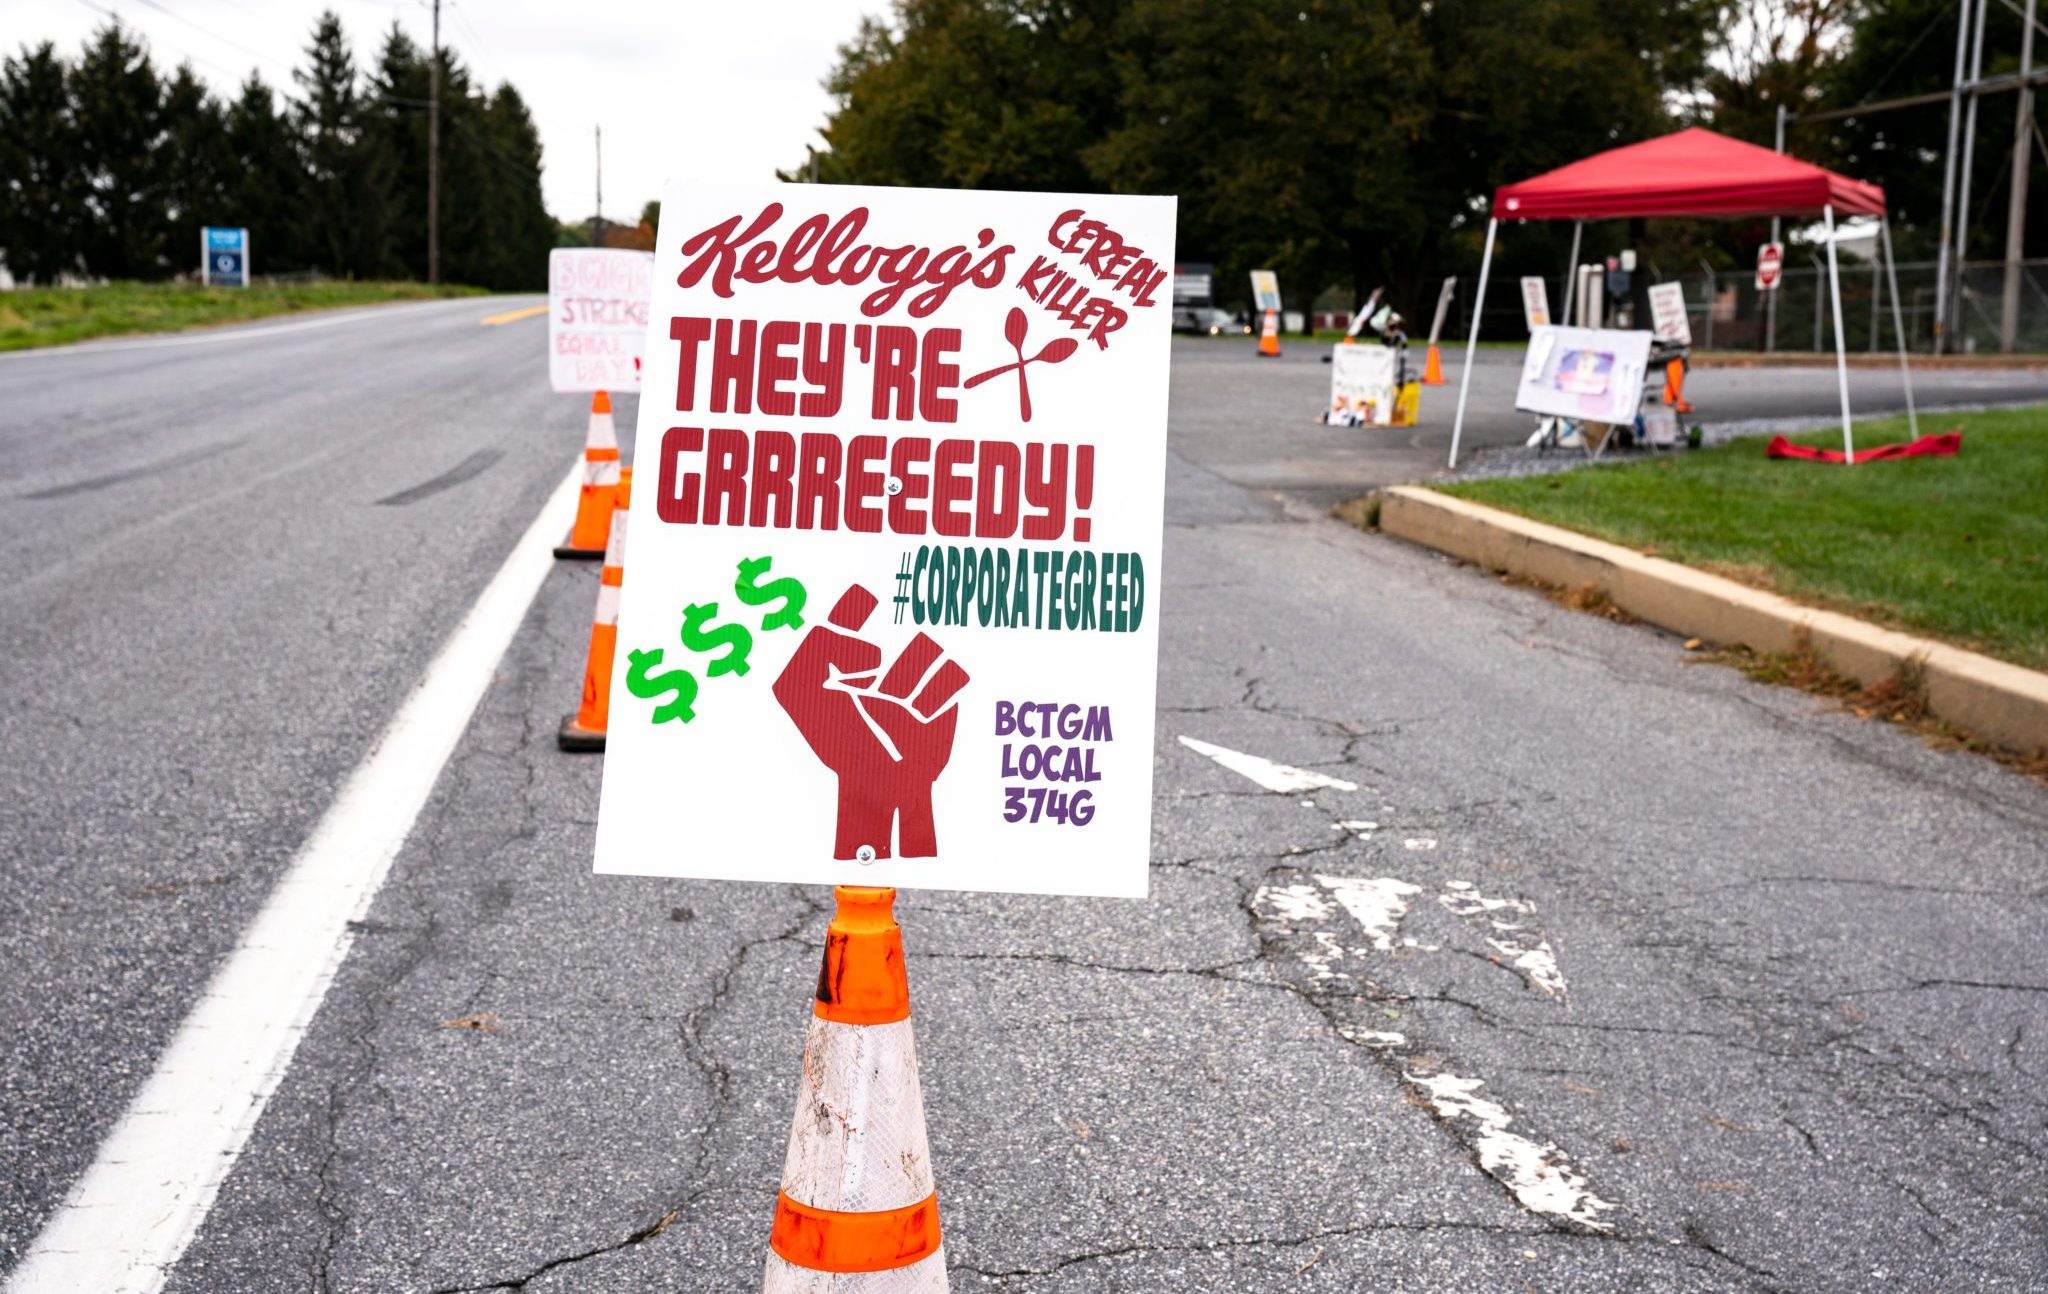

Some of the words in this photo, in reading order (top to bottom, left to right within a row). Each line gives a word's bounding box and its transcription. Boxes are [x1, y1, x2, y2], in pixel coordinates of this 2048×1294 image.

[677, 202, 1016, 318] Kellogg's
[1016, 255, 1129, 351] KILLER
[1048, 209, 1168, 307] CEREAL
[669, 317, 962, 423] THEY'RE
[656, 427, 1095, 543] GRRREEEDY!
[893, 545, 1145, 633] #CORPORATEGREED
[995, 701, 1113, 742] BCTGM
[1001, 744, 1102, 783] LOCAL
[1003, 787, 1096, 827] 374G
